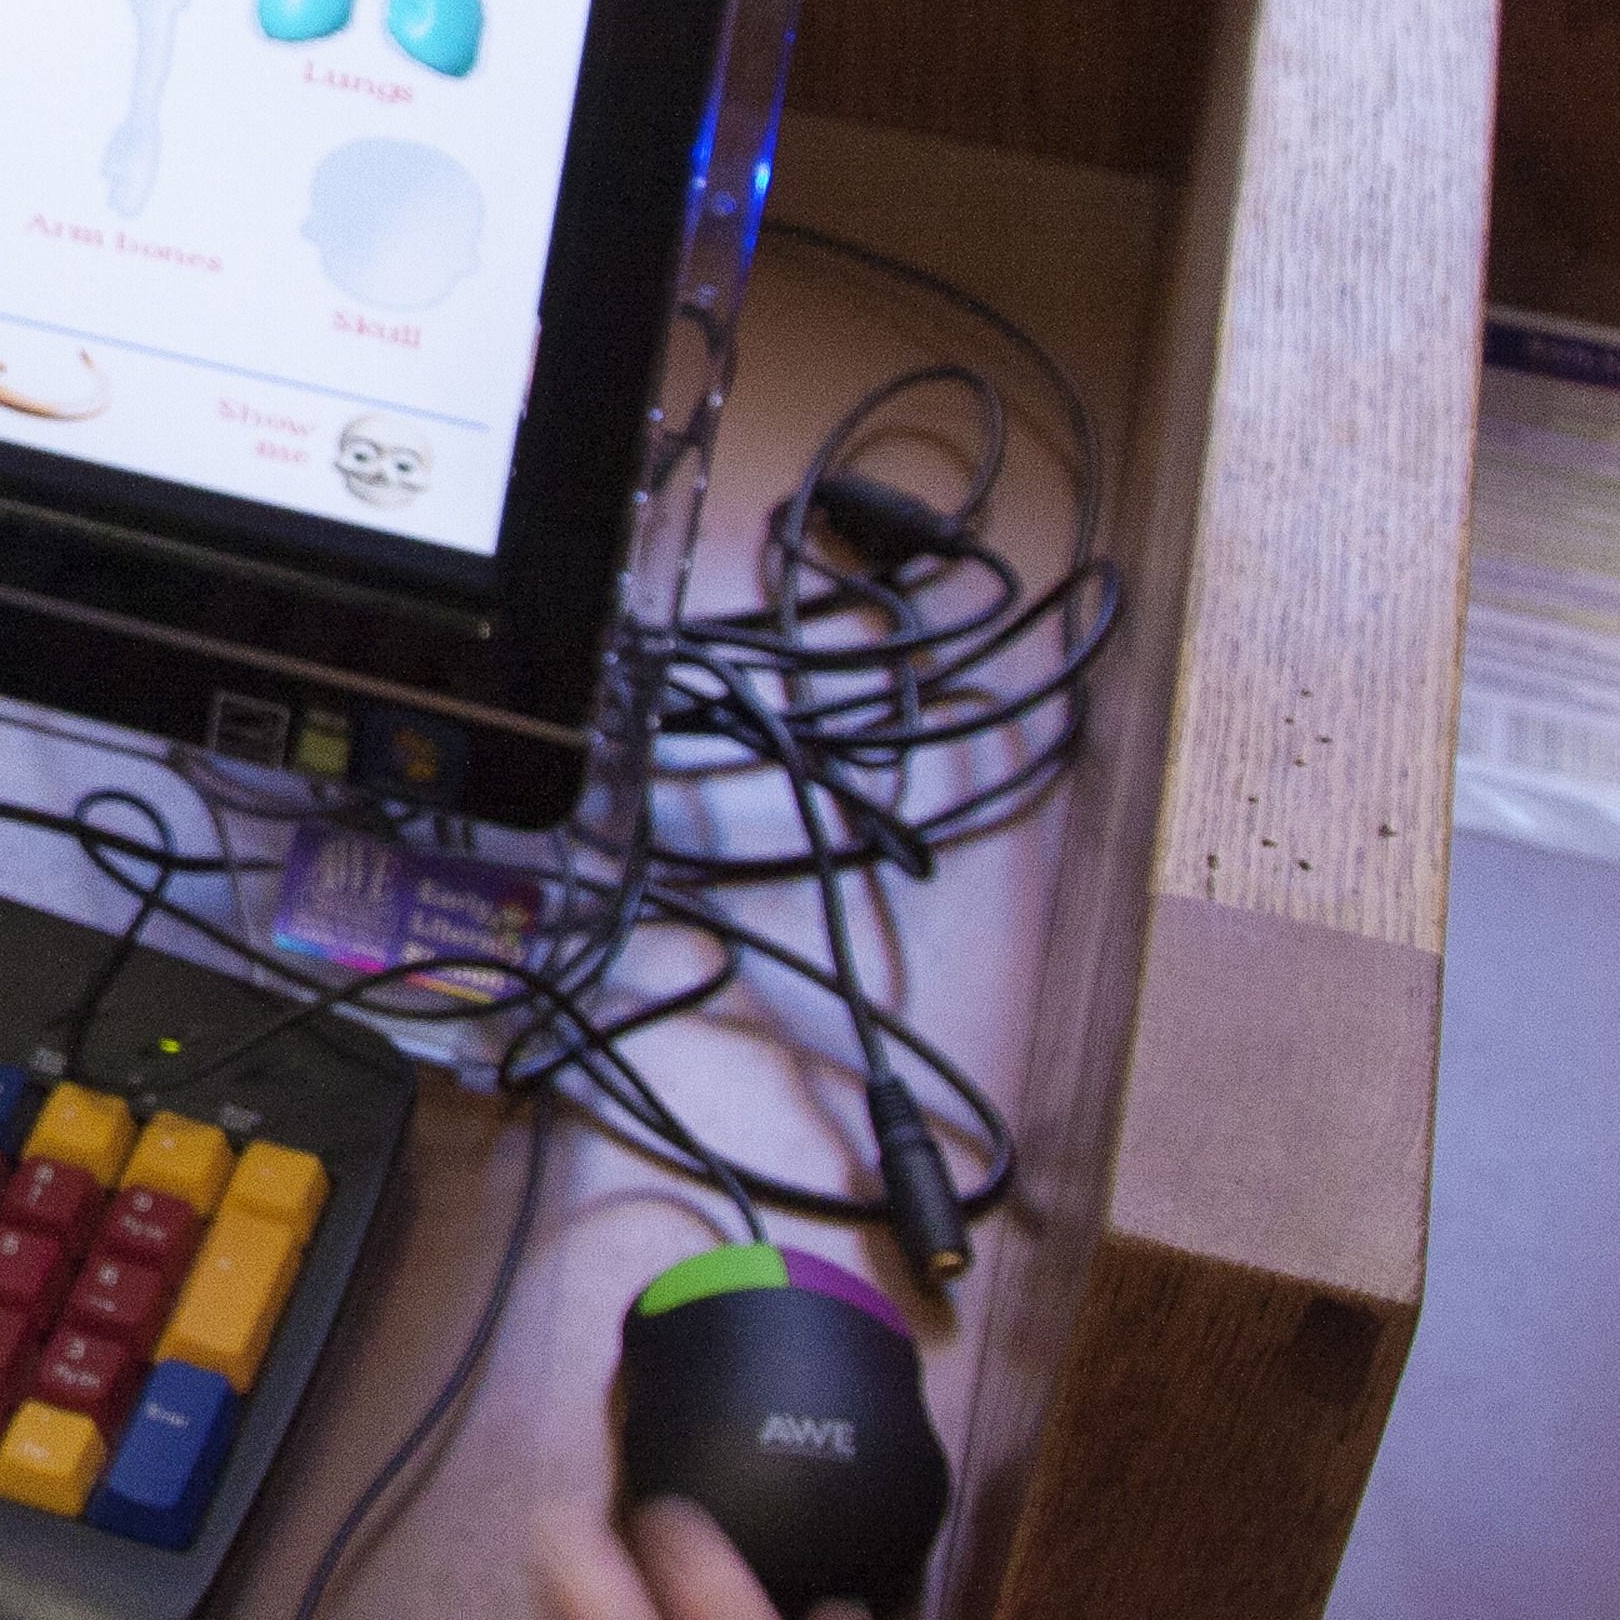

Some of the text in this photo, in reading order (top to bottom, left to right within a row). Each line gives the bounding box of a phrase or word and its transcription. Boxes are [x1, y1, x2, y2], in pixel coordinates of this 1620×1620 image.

[303, 58, 415, 105] Lungs
[27, 211, 225, 274] Arm bones
[332, 309, 424, 349] Skull
[217, 397, 320, 438] Show
[760, 1413, 857, 1458] AWE
